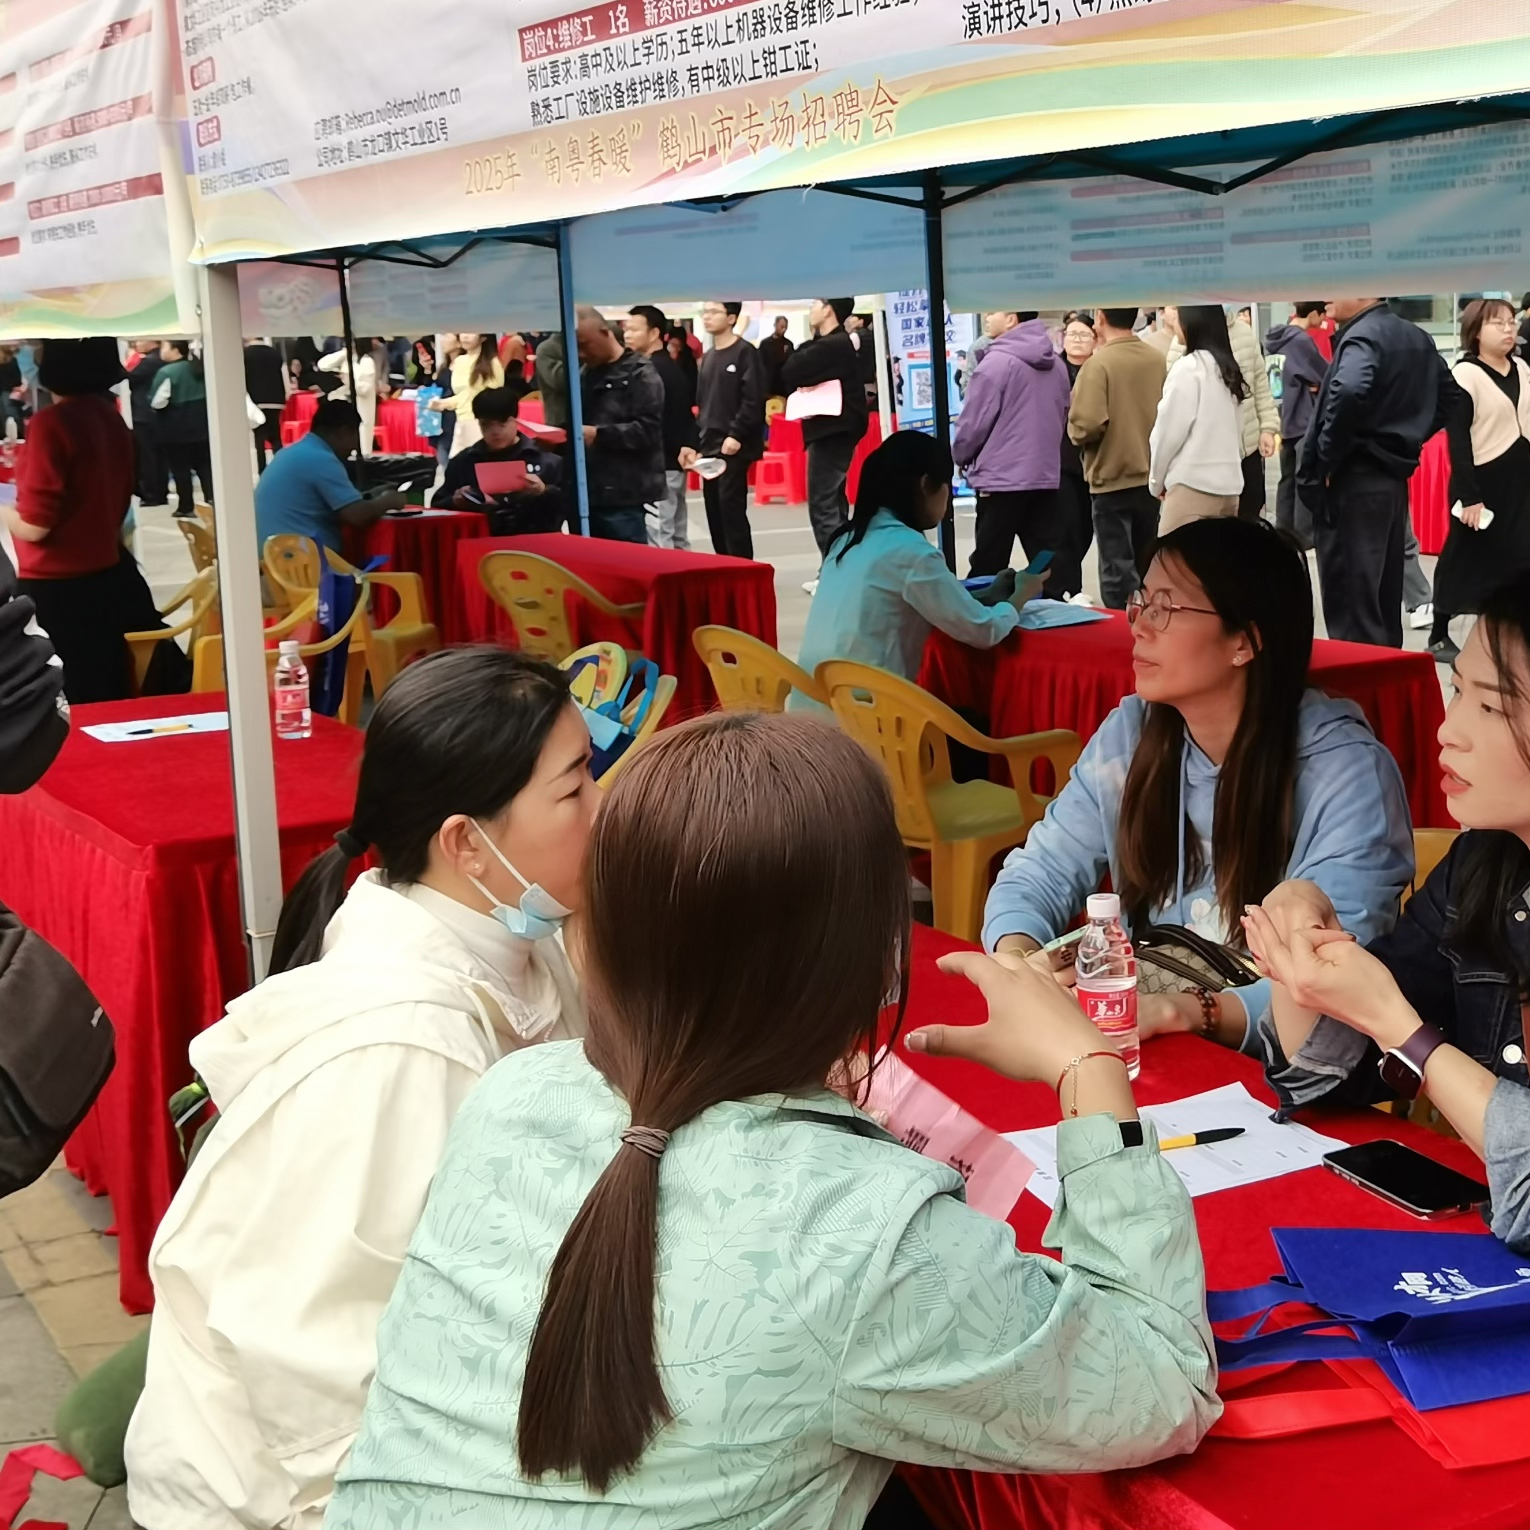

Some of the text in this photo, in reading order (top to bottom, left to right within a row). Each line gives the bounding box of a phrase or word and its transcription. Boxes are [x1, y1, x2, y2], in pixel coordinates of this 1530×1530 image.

[522, 16, 596, 58] 岗位4:维修工
[609, 6, 630, 35] 1名
